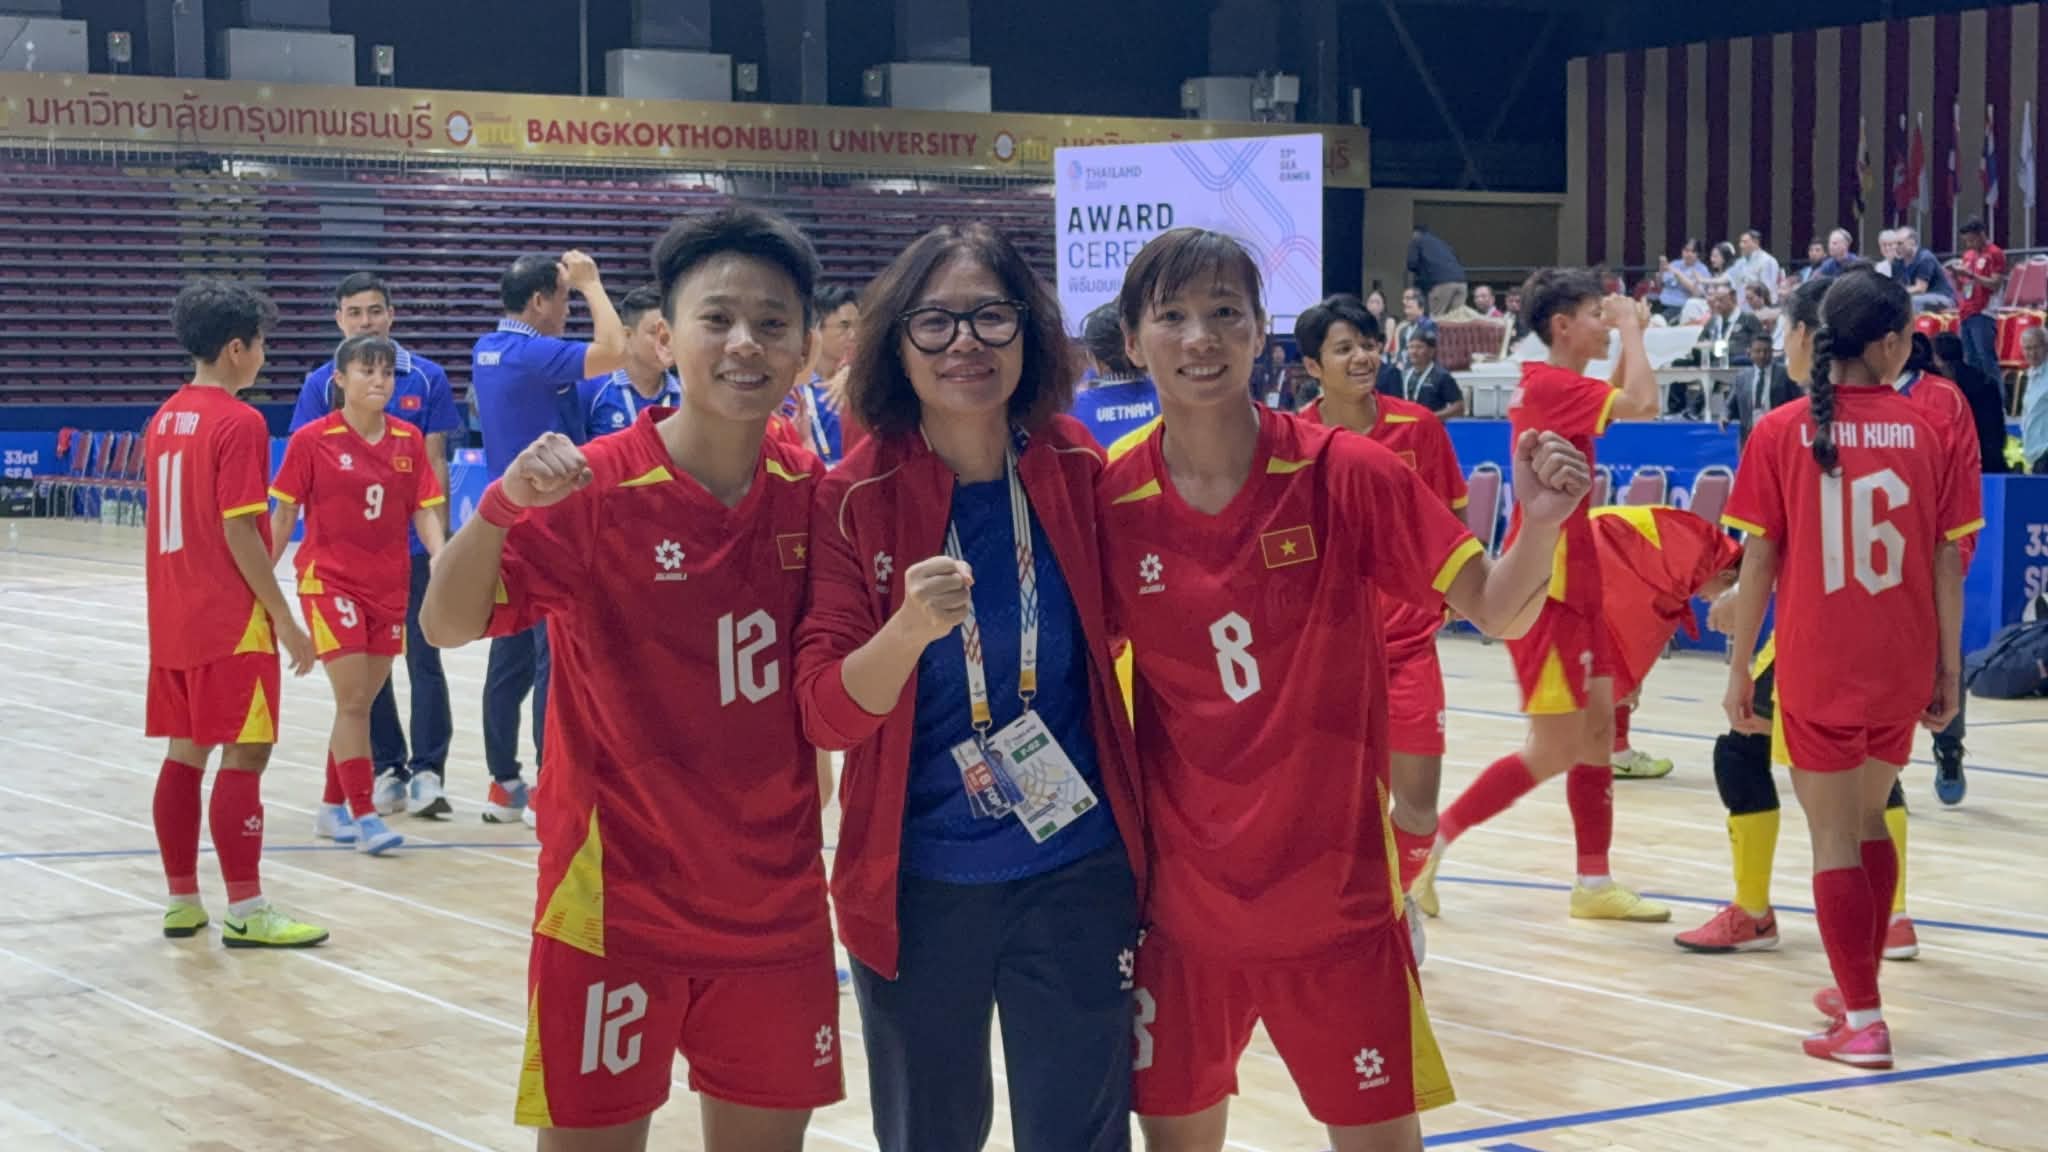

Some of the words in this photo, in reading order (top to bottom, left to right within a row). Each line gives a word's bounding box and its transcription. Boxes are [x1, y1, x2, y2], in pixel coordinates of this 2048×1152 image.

[26, 91, 432, 148] มหาวิทยาลัยกรุงเทพธนบุรี
[527, 118, 818, 152] BANGKOKTHONBURI
[829, 129, 977, 157] UNIVERSITY
[1085, 165, 1143, 178] THAILAND
[1067, 203, 1174, 233] AWARD
[1068, 240, 1146, 269] CERE
[1096, 402, 1154, 422] VIETNAM
[4, 450, 39, 465] 33rd
[157, 451, 184, 554] 11
[364, 483, 385, 521] 9
[1820, 466, 1910, 596] 16
[334, 596, 359, 628] 9
[718, 609, 780, 707] 12
[1208, 611, 1262, 704] 8
[580, 981, 648, 1075] 12
